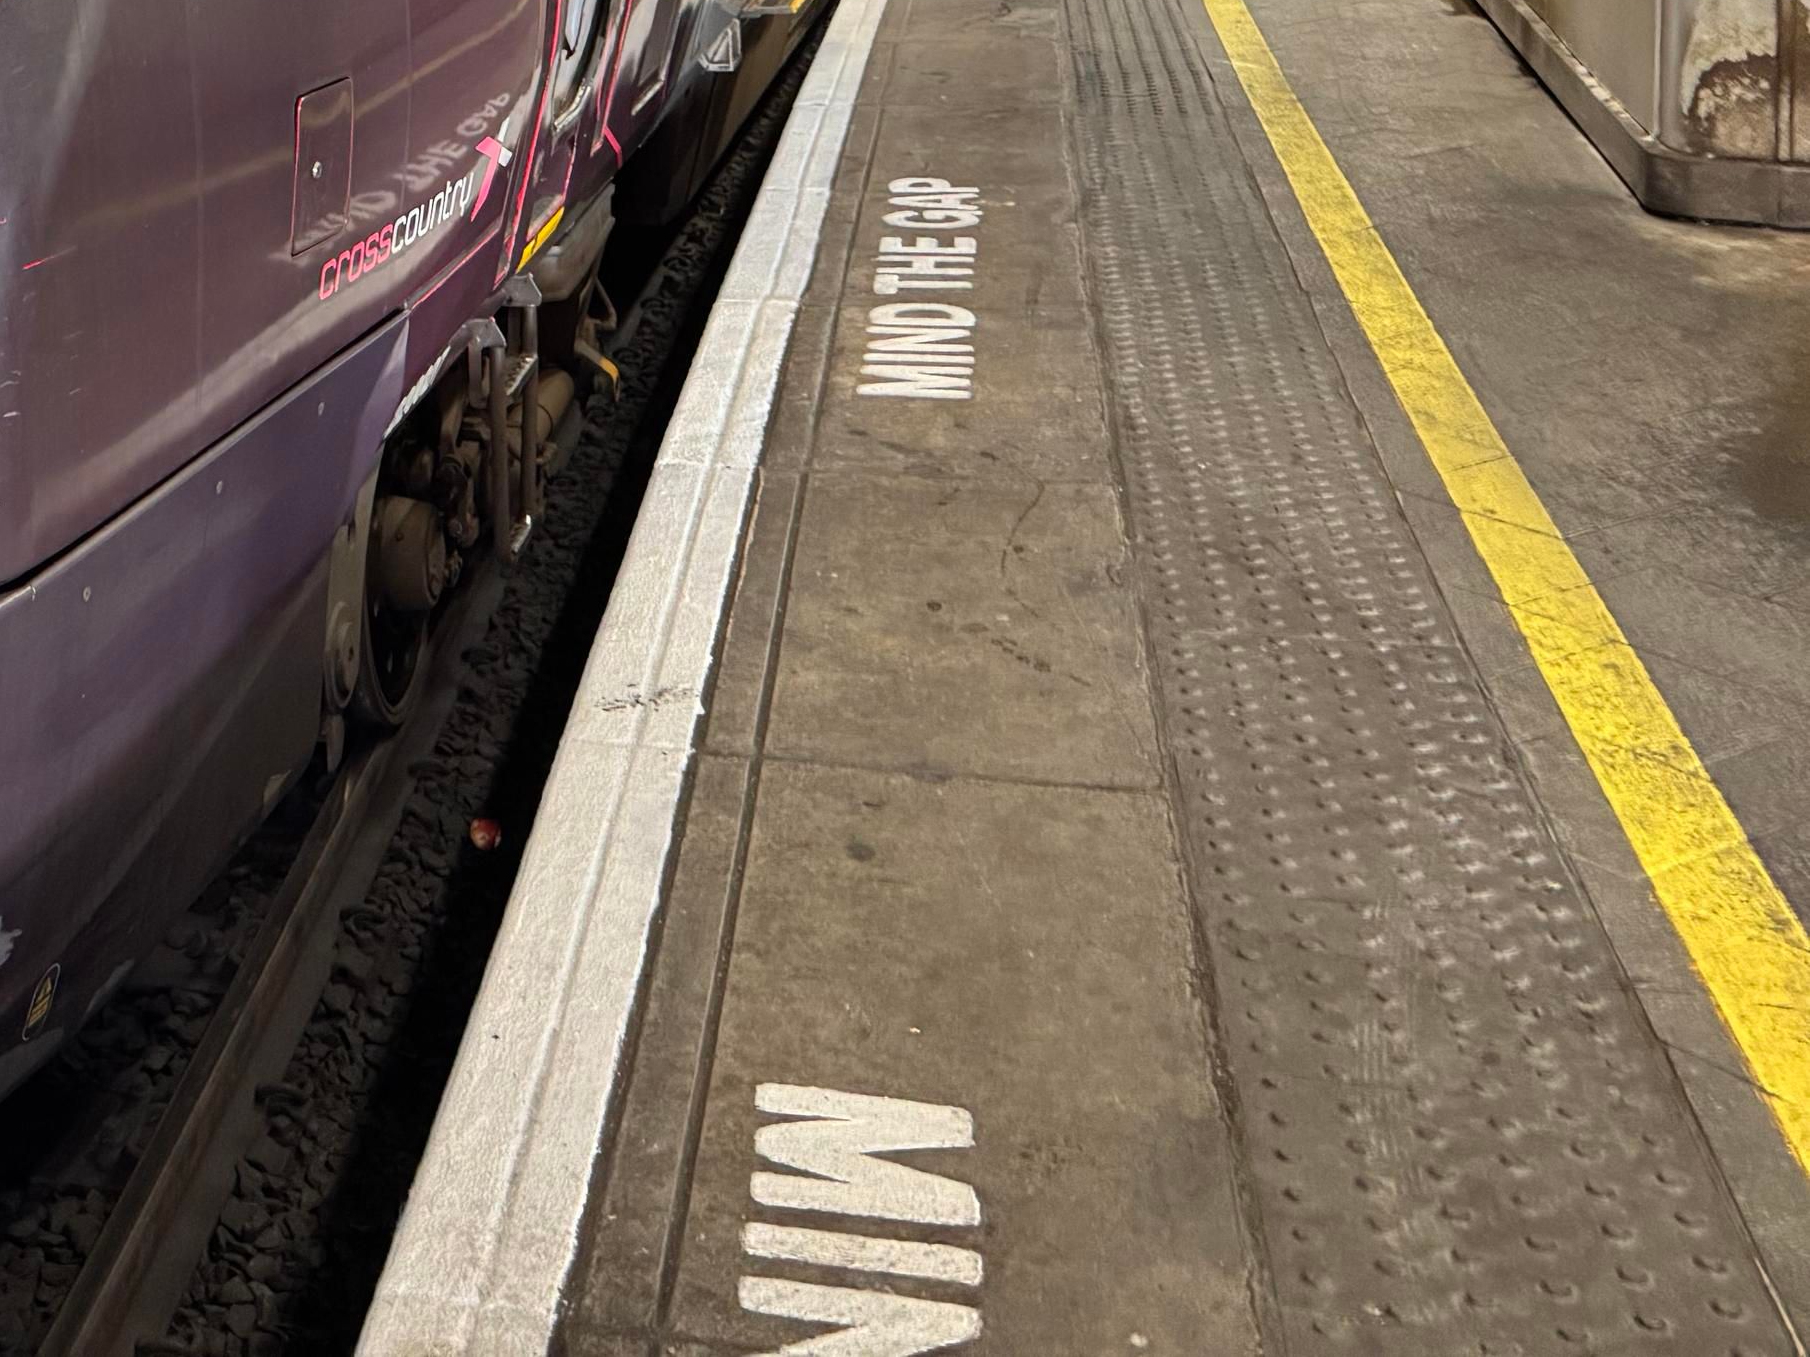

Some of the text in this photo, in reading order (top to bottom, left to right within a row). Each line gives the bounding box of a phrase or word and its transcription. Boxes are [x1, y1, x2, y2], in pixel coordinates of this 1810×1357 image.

[318, 170, 475, 300] crosscountry
[855, 177, 984, 400] MIND THE GAP
